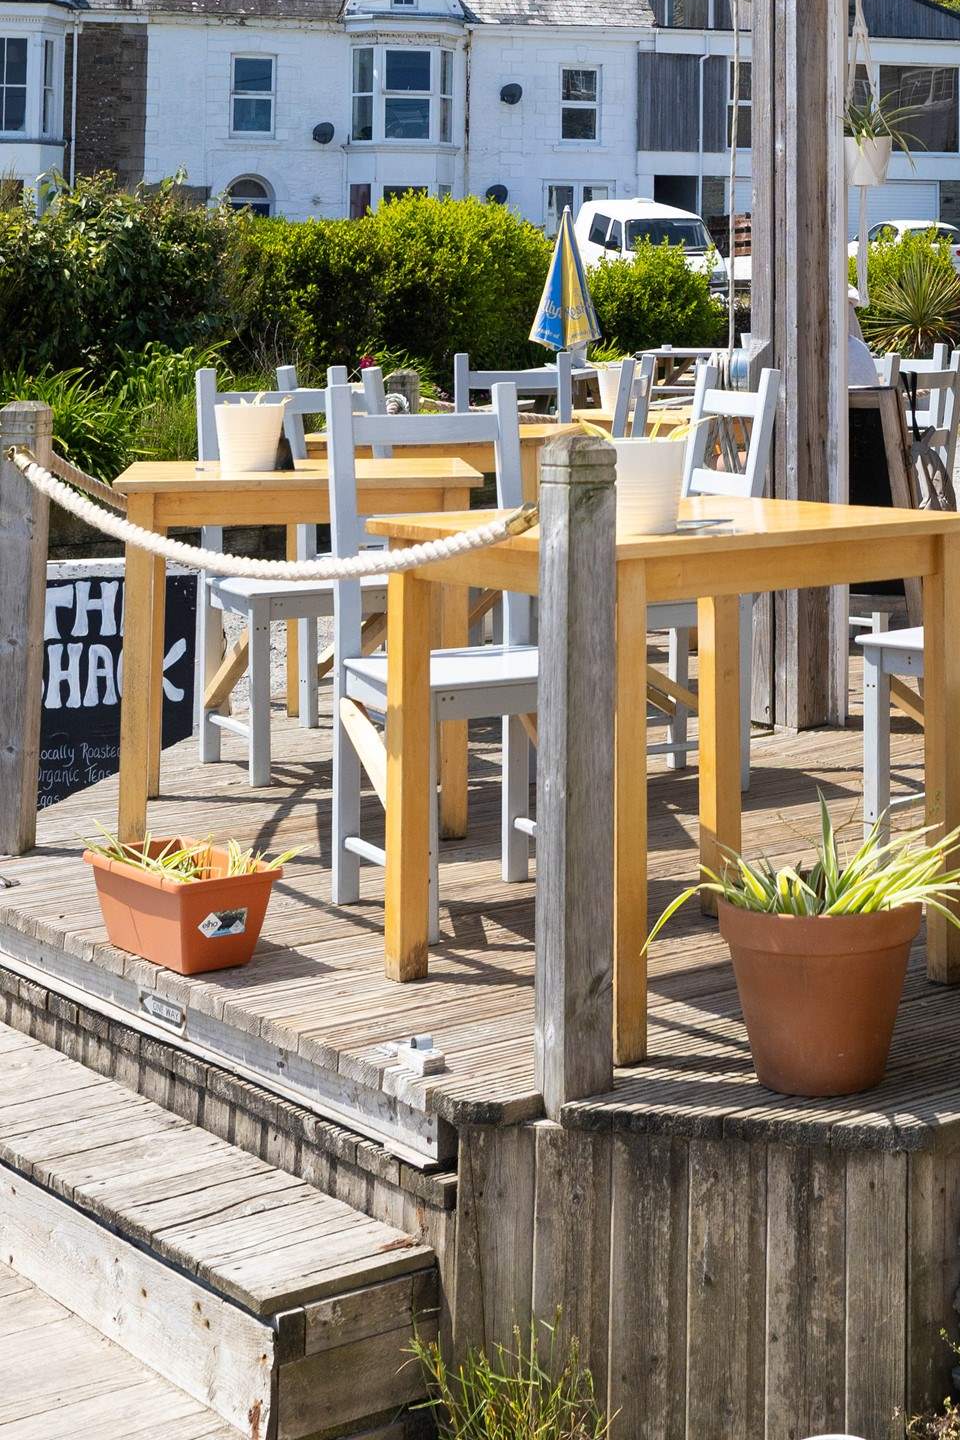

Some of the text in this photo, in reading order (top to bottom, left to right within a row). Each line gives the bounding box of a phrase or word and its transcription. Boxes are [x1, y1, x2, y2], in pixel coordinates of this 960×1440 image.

[43, 581, 126, 640] TH
[42, 638, 187, 709] HAK
[39, 744, 75, 768] ocally
[165, 1006, 179, 1021] WAY
